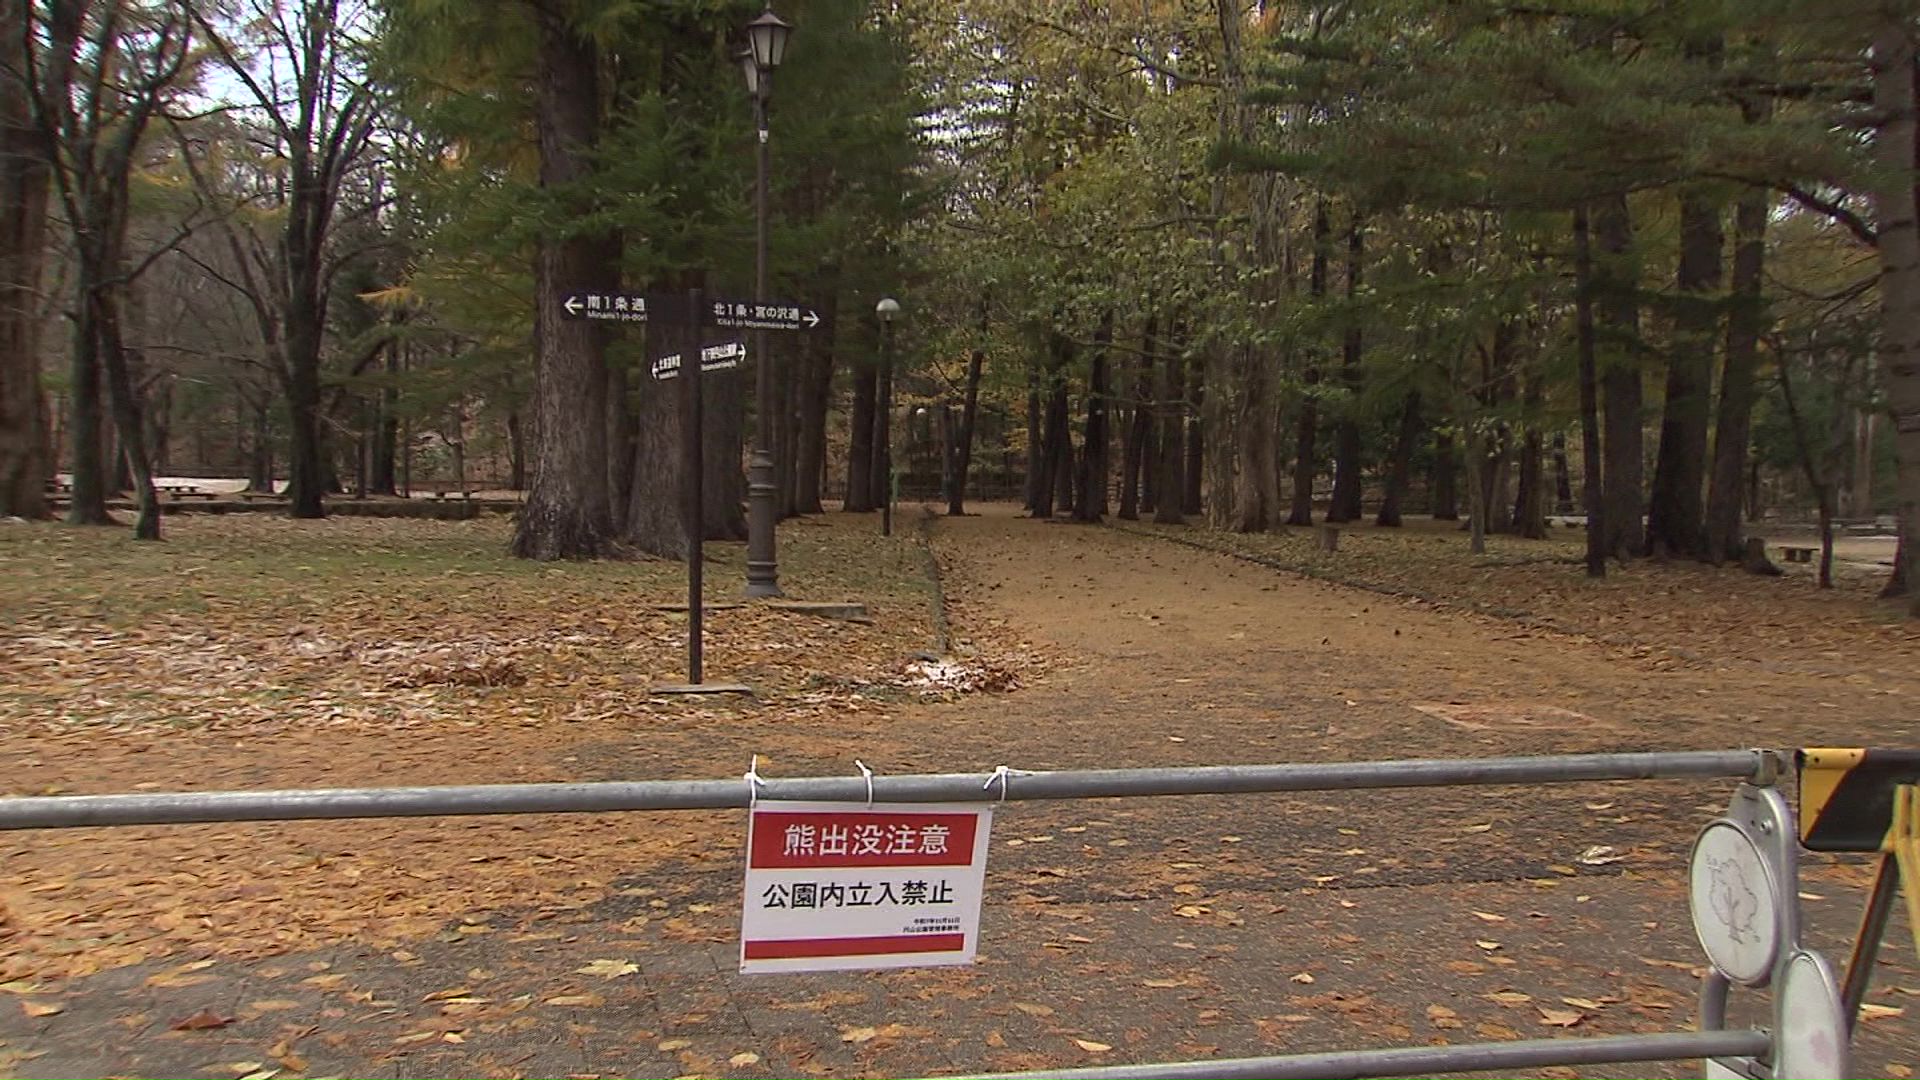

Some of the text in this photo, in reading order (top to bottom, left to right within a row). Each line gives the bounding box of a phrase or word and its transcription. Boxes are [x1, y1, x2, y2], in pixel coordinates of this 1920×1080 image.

[783, 823, 950, 857] 熊出没注意
[762, 880, 954, 910] 公園内立入禁止
